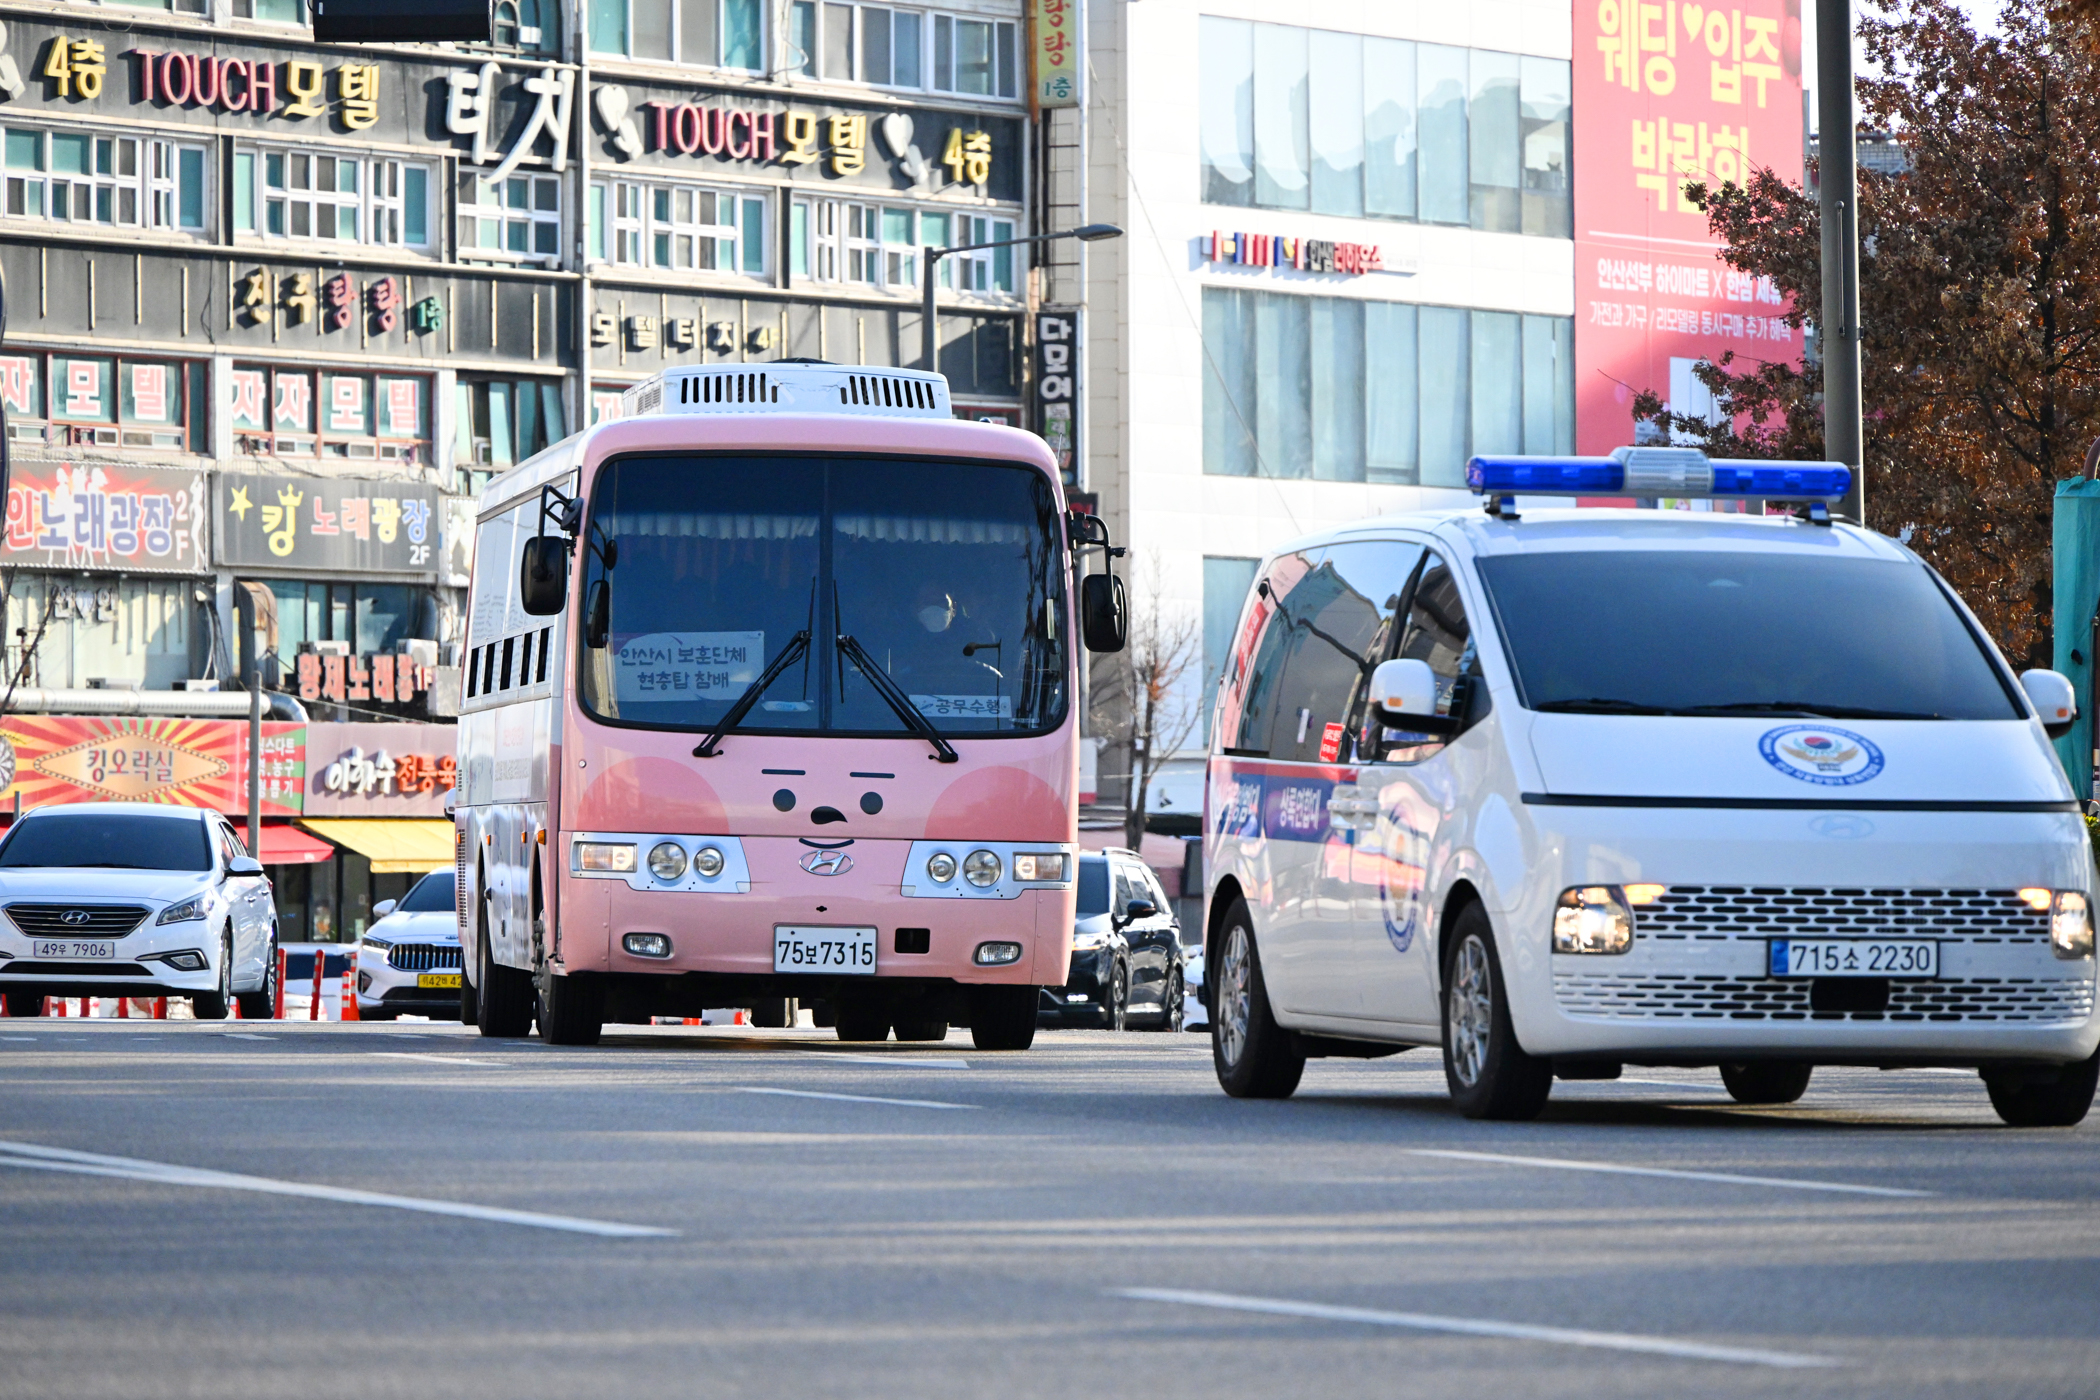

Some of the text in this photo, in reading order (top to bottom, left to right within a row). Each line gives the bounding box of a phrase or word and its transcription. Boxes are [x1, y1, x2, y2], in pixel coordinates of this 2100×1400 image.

[1597, 0, 1782, 109] 웨딩 입주
[44, 36, 380, 130] 4층 TOUCH 모텔
[1045, 77, 1072, 98] 1층
[446, 62, 576, 185] 터치
[648, 101, 992, 185] TOUCH 모텔 4층
[1598, 258, 1652, 292] 안산선부
[1656, 264, 1709, 298] 하이마트
[592, 313, 780, 351] 모텔터치 4F
[1590, 301, 1622, 327] 가전과
[1625, 304, 1647, 330] 가구
[1657, 308, 1698, 334] 리모델링
[1702, 311, 1743, 339] 동시구매
[1746, 317, 1768, 339] 추가
[1040, 317, 1073, 399] 다모여
[262, 497, 431, 556] 킹 노래광장
[409, 545, 430, 564] 2F
[620, 646, 746, 666] 안산시 보훈단체
[637, 671, 729, 690] 현충탑 참배
[935, 699, 1001, 715] 공무수행
[87, 749, 174, 783] 킹오락실
[42, 943, 106, 956] 49우 7906
[778, 940, 873, 966] 75보7315
[1792, 945, 1931, 971] 715소 2230
